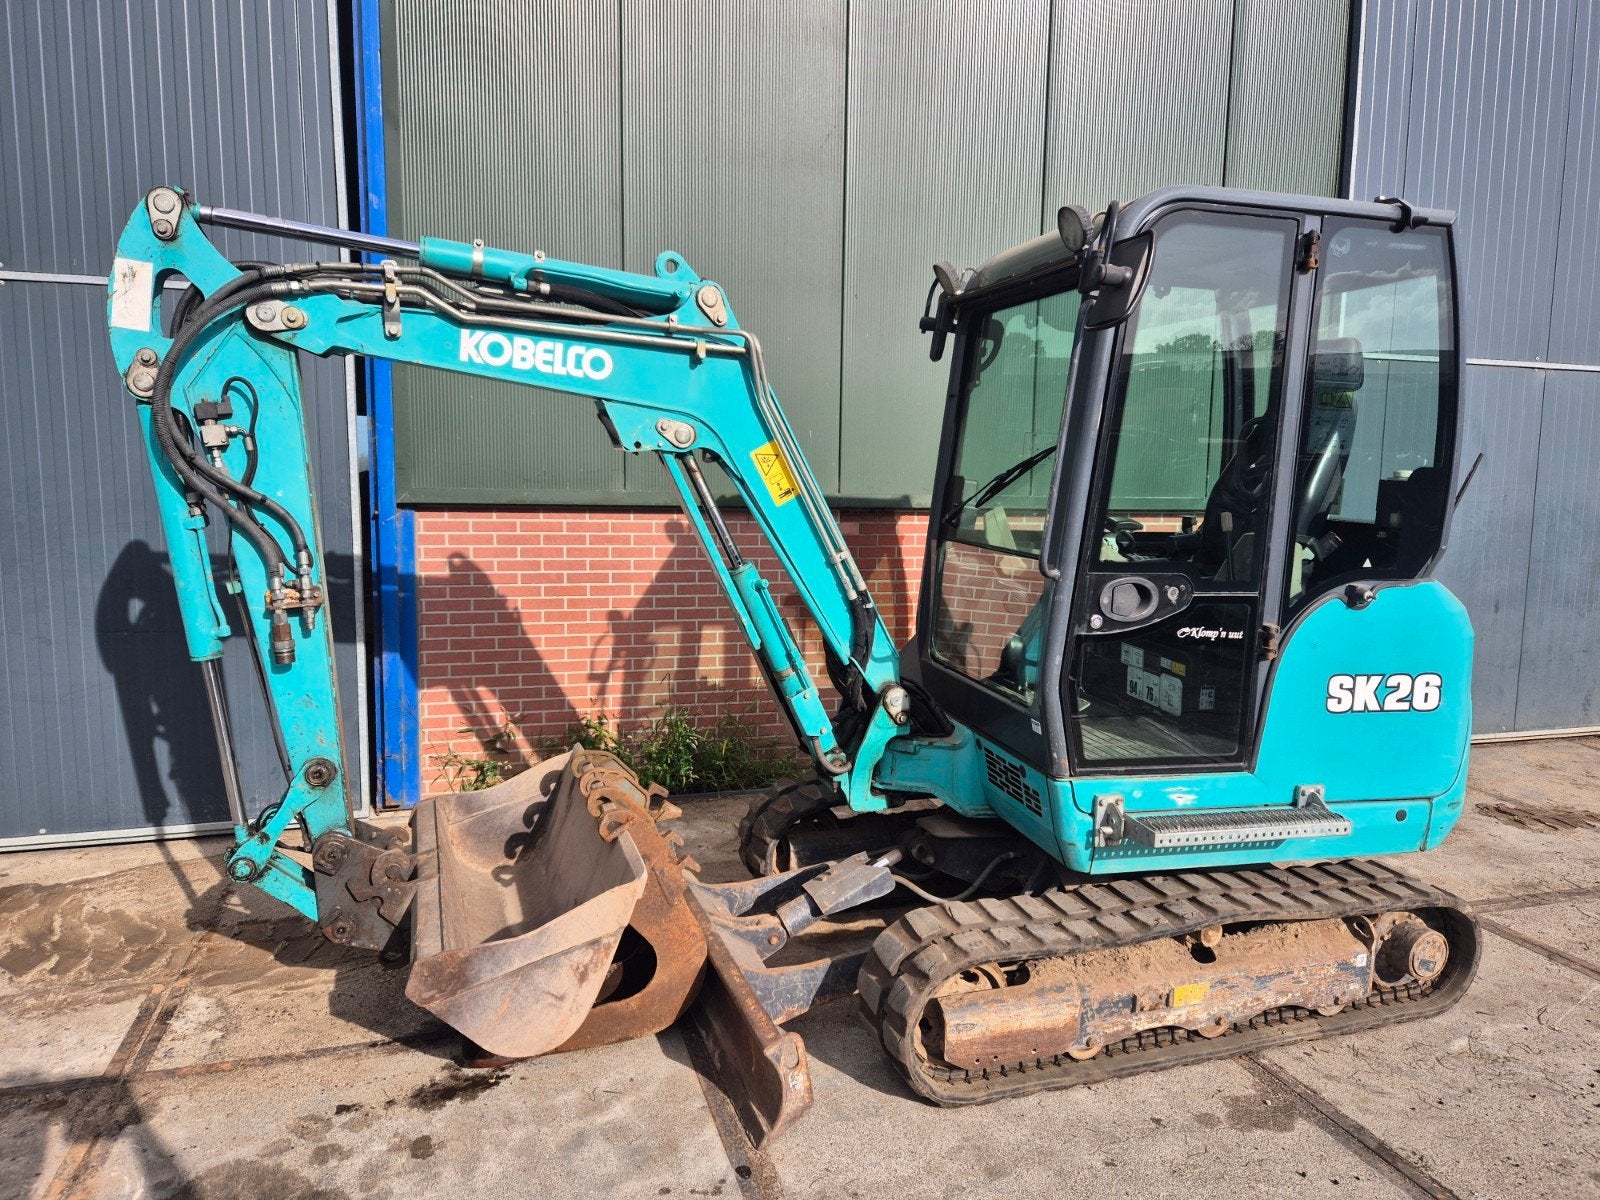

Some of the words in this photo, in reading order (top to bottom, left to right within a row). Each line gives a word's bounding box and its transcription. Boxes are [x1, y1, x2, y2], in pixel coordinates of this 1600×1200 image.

[459, 328, 613, 380] KOBELCO
[1129, 679, 1138, 696] 94
[1326, 672, 1443, 714] SK26
